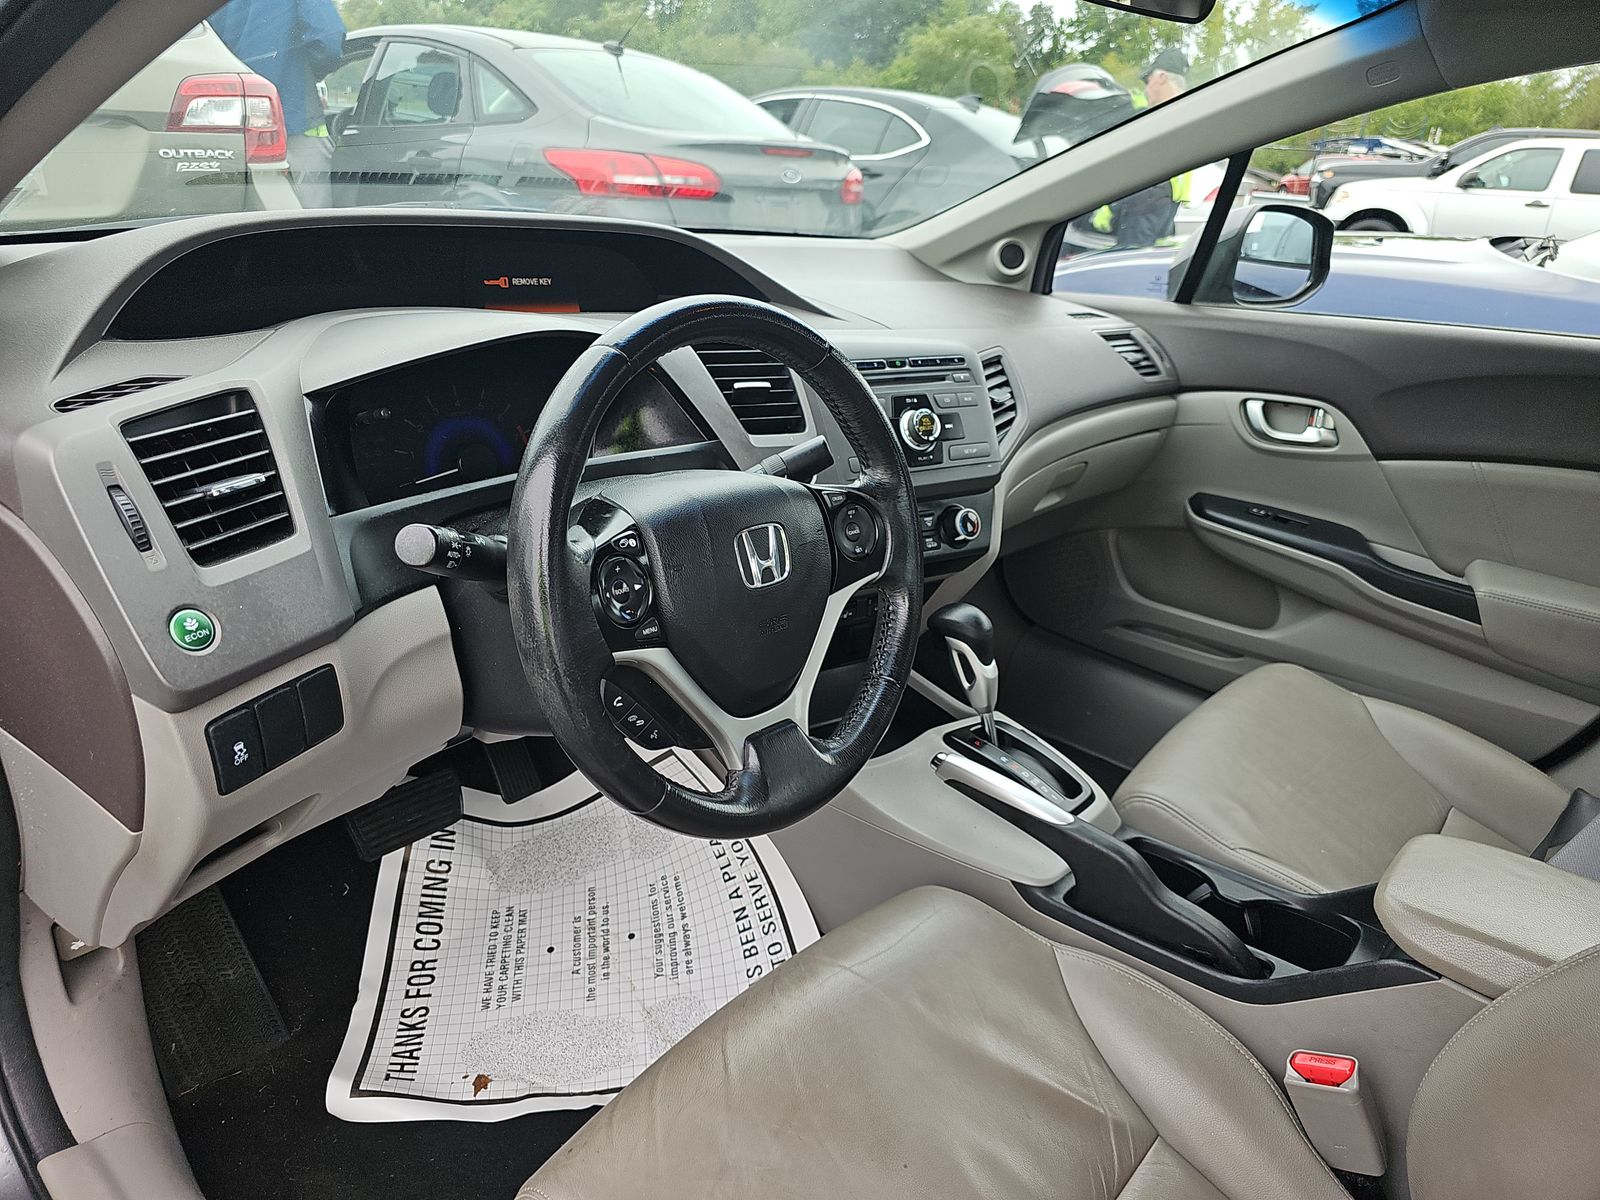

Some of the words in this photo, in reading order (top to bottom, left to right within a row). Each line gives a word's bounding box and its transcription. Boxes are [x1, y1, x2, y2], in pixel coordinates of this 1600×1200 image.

[158, 148, 235, 159] OUTBACK
[511, 277, 538, 286] REMOVE
[539, 277, 552, 286] KEY
[184, 628, 210, 643] ECON
[642, 626, 658, 635] MENU
[234, 753, 249, 766] OFF
[430, 828, 456, 850] IN
[709, 839, 736, 883] PLEA
[731, 840, 750, 867] YO
[588, 886, 597, 916] person
[648, 883, 657, 897] for
[661, 874, 673, 912] service
[729, 886, 743, 899] A
[413, 858, 453, 951] COMING
[602, 901, 610, 915] us.
[745, 869, 777, 936] SERVE
[491, 909, 500, 929] KEEP
[504, 905, 514, 932] CLEAN
[518, 908, 528, 926] MAT
[572, 915, 581, 924] is
[601, 917, 610, 927] to
[651, 898, 664, 955] suggestions
[666, 913, 675, 929] our
[489, 932, 499, 942] TO
[516, 928, 527, 955] PAPER
[587, 918, 597, 960] important
[601, 927, 610, 953] world
[681, 922, 692, 957] always
[733, 906, 759, 959] BEEN
[486, 944, 497, 969] TRIED
[573, 925, 581, 967] customer
[669, 931, 680, 980] improving
[767, 941, 786, 969] TO
[499, 934, 512, 982] CARPETING
[514, 957, 524, 978] THIS
[601, 955, 610, 970] the
[654, 958, 664, 979] Your
[685, 959, 694, 976] are
[404, 958, 438, 999] FOR
[483, 971, 495, 994] HAVE
[587, 962, 596, 984] most
[600, 972, 610, 981] in
[496, 984, 508, 1010] YOUR
[512, 979, 522, 1002] WITH
[586, 987, 596, 1002] the
[481, 996, 492, 1011] WE
[384, 1006, 430, 1081] THANKS
